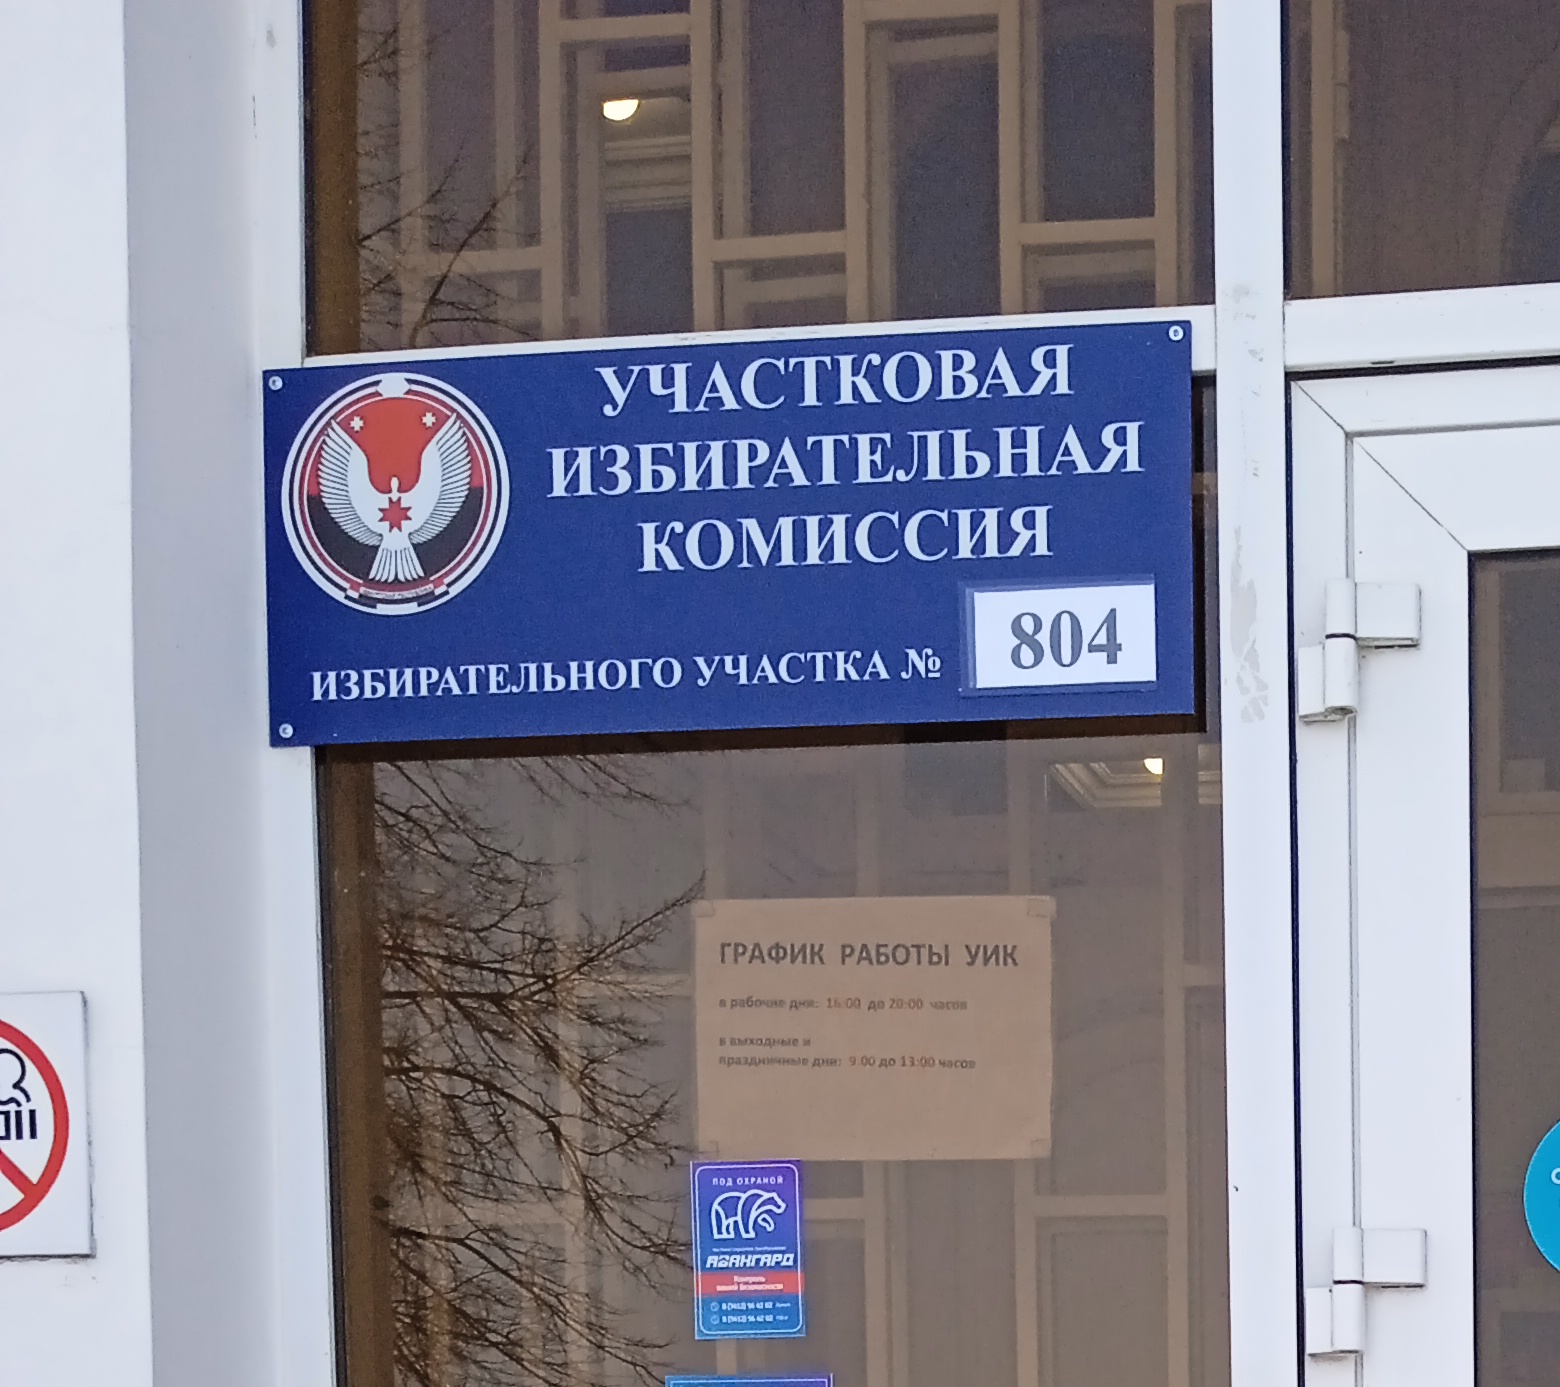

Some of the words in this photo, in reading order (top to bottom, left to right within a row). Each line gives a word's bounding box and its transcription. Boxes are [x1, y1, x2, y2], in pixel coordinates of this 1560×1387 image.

[594, 343, 1075, 418] УЧАСТКОВАЯ
[545, 421, 1145, 498] ИЗБИРАТЕЛЬНАЯ
[637, 505, 1054, 572] КОМИССИЯ
[311, 656, 682, 701] ИЗБИРАТЕЛЬНОГО
[693, 650, 890, 688] УЧАСТКА
[1009, 606, 1123, 670] 804
[720, 942, 825, 965] ГРАФИК
[841, 943, 950, 967] РАБОТЫ
[964, 944, 1019, 967] УИК
[867, 999, 885, 1011] до
[878, 1057, 896, 1069] до
[712, 1177, 733, 1187] ПОД
[736, 1175, 784, 1186] ОХРАНОЙ
[705, 1253, 795, 1269] АВАНГАРД
